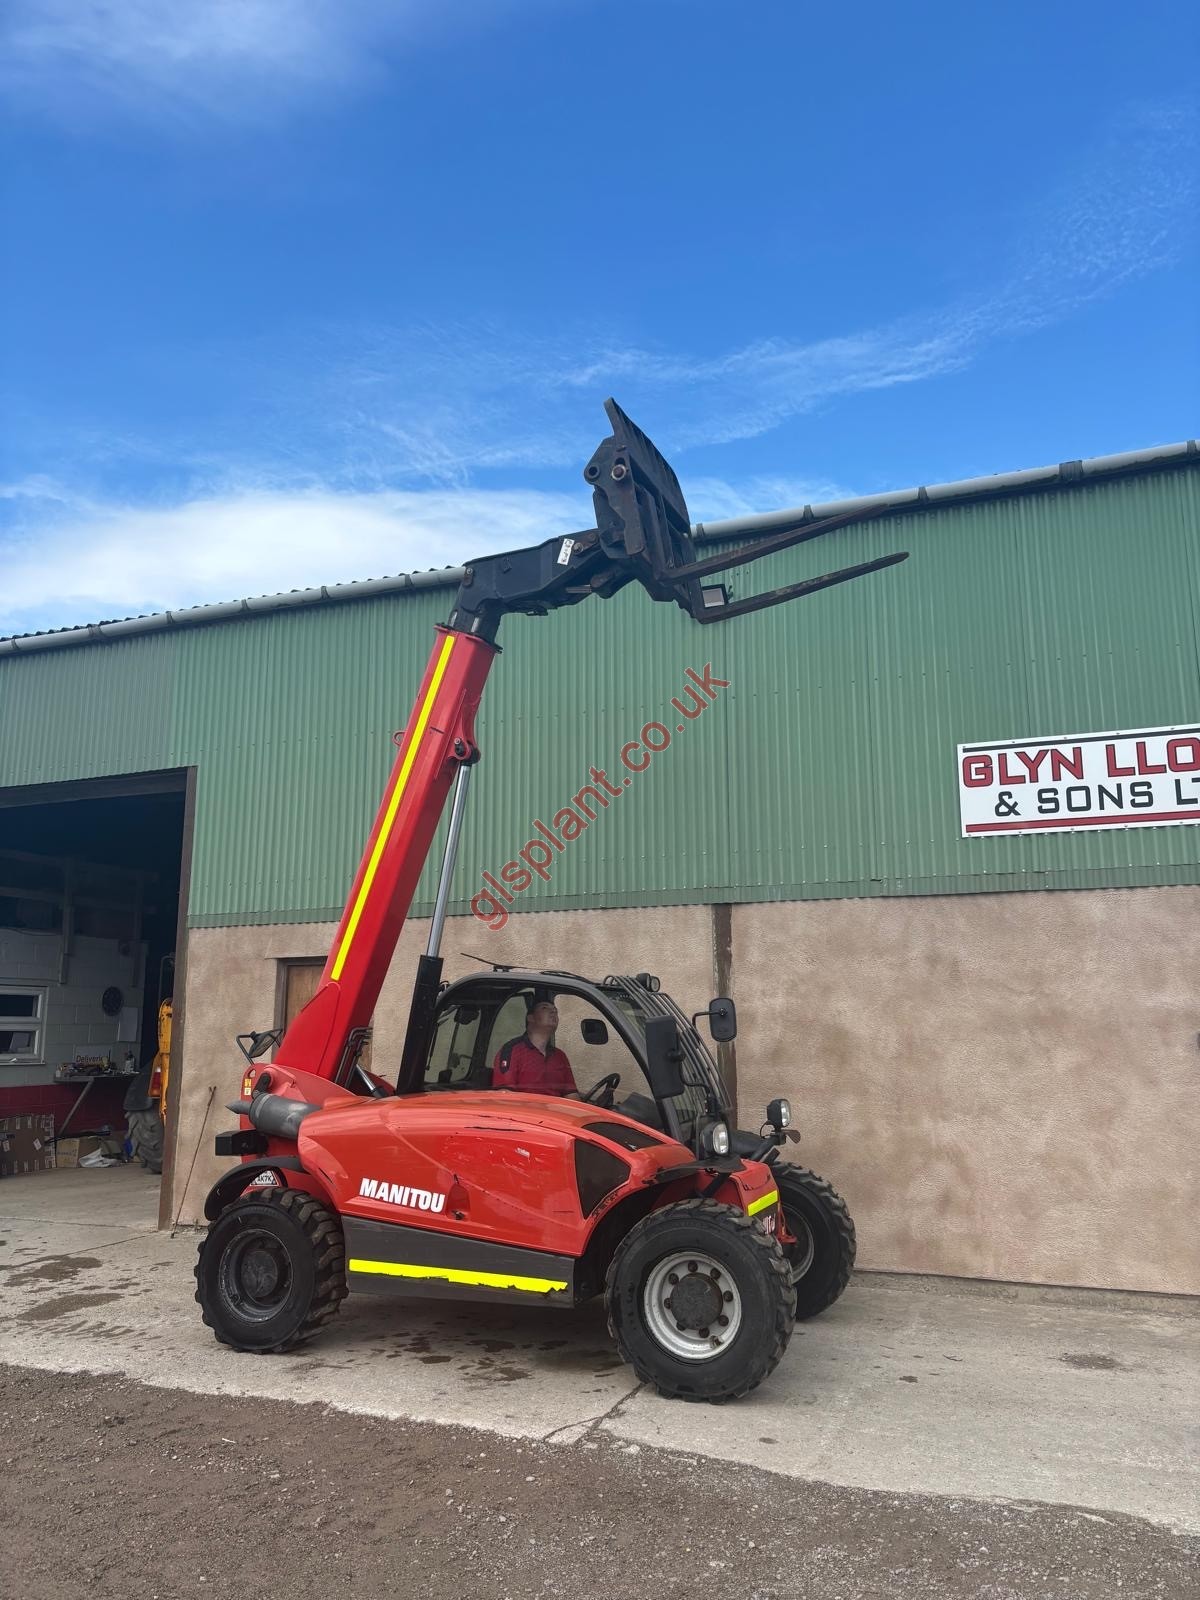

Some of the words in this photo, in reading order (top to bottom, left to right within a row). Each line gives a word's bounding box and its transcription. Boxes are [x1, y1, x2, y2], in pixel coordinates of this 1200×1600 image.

[963, 747, 1084, 788] GLYN
[994, 791, 1022, 817] &
[1037, 781, 1154, 814] SONS
[359, 1177, 446, 1213] MANITOU
